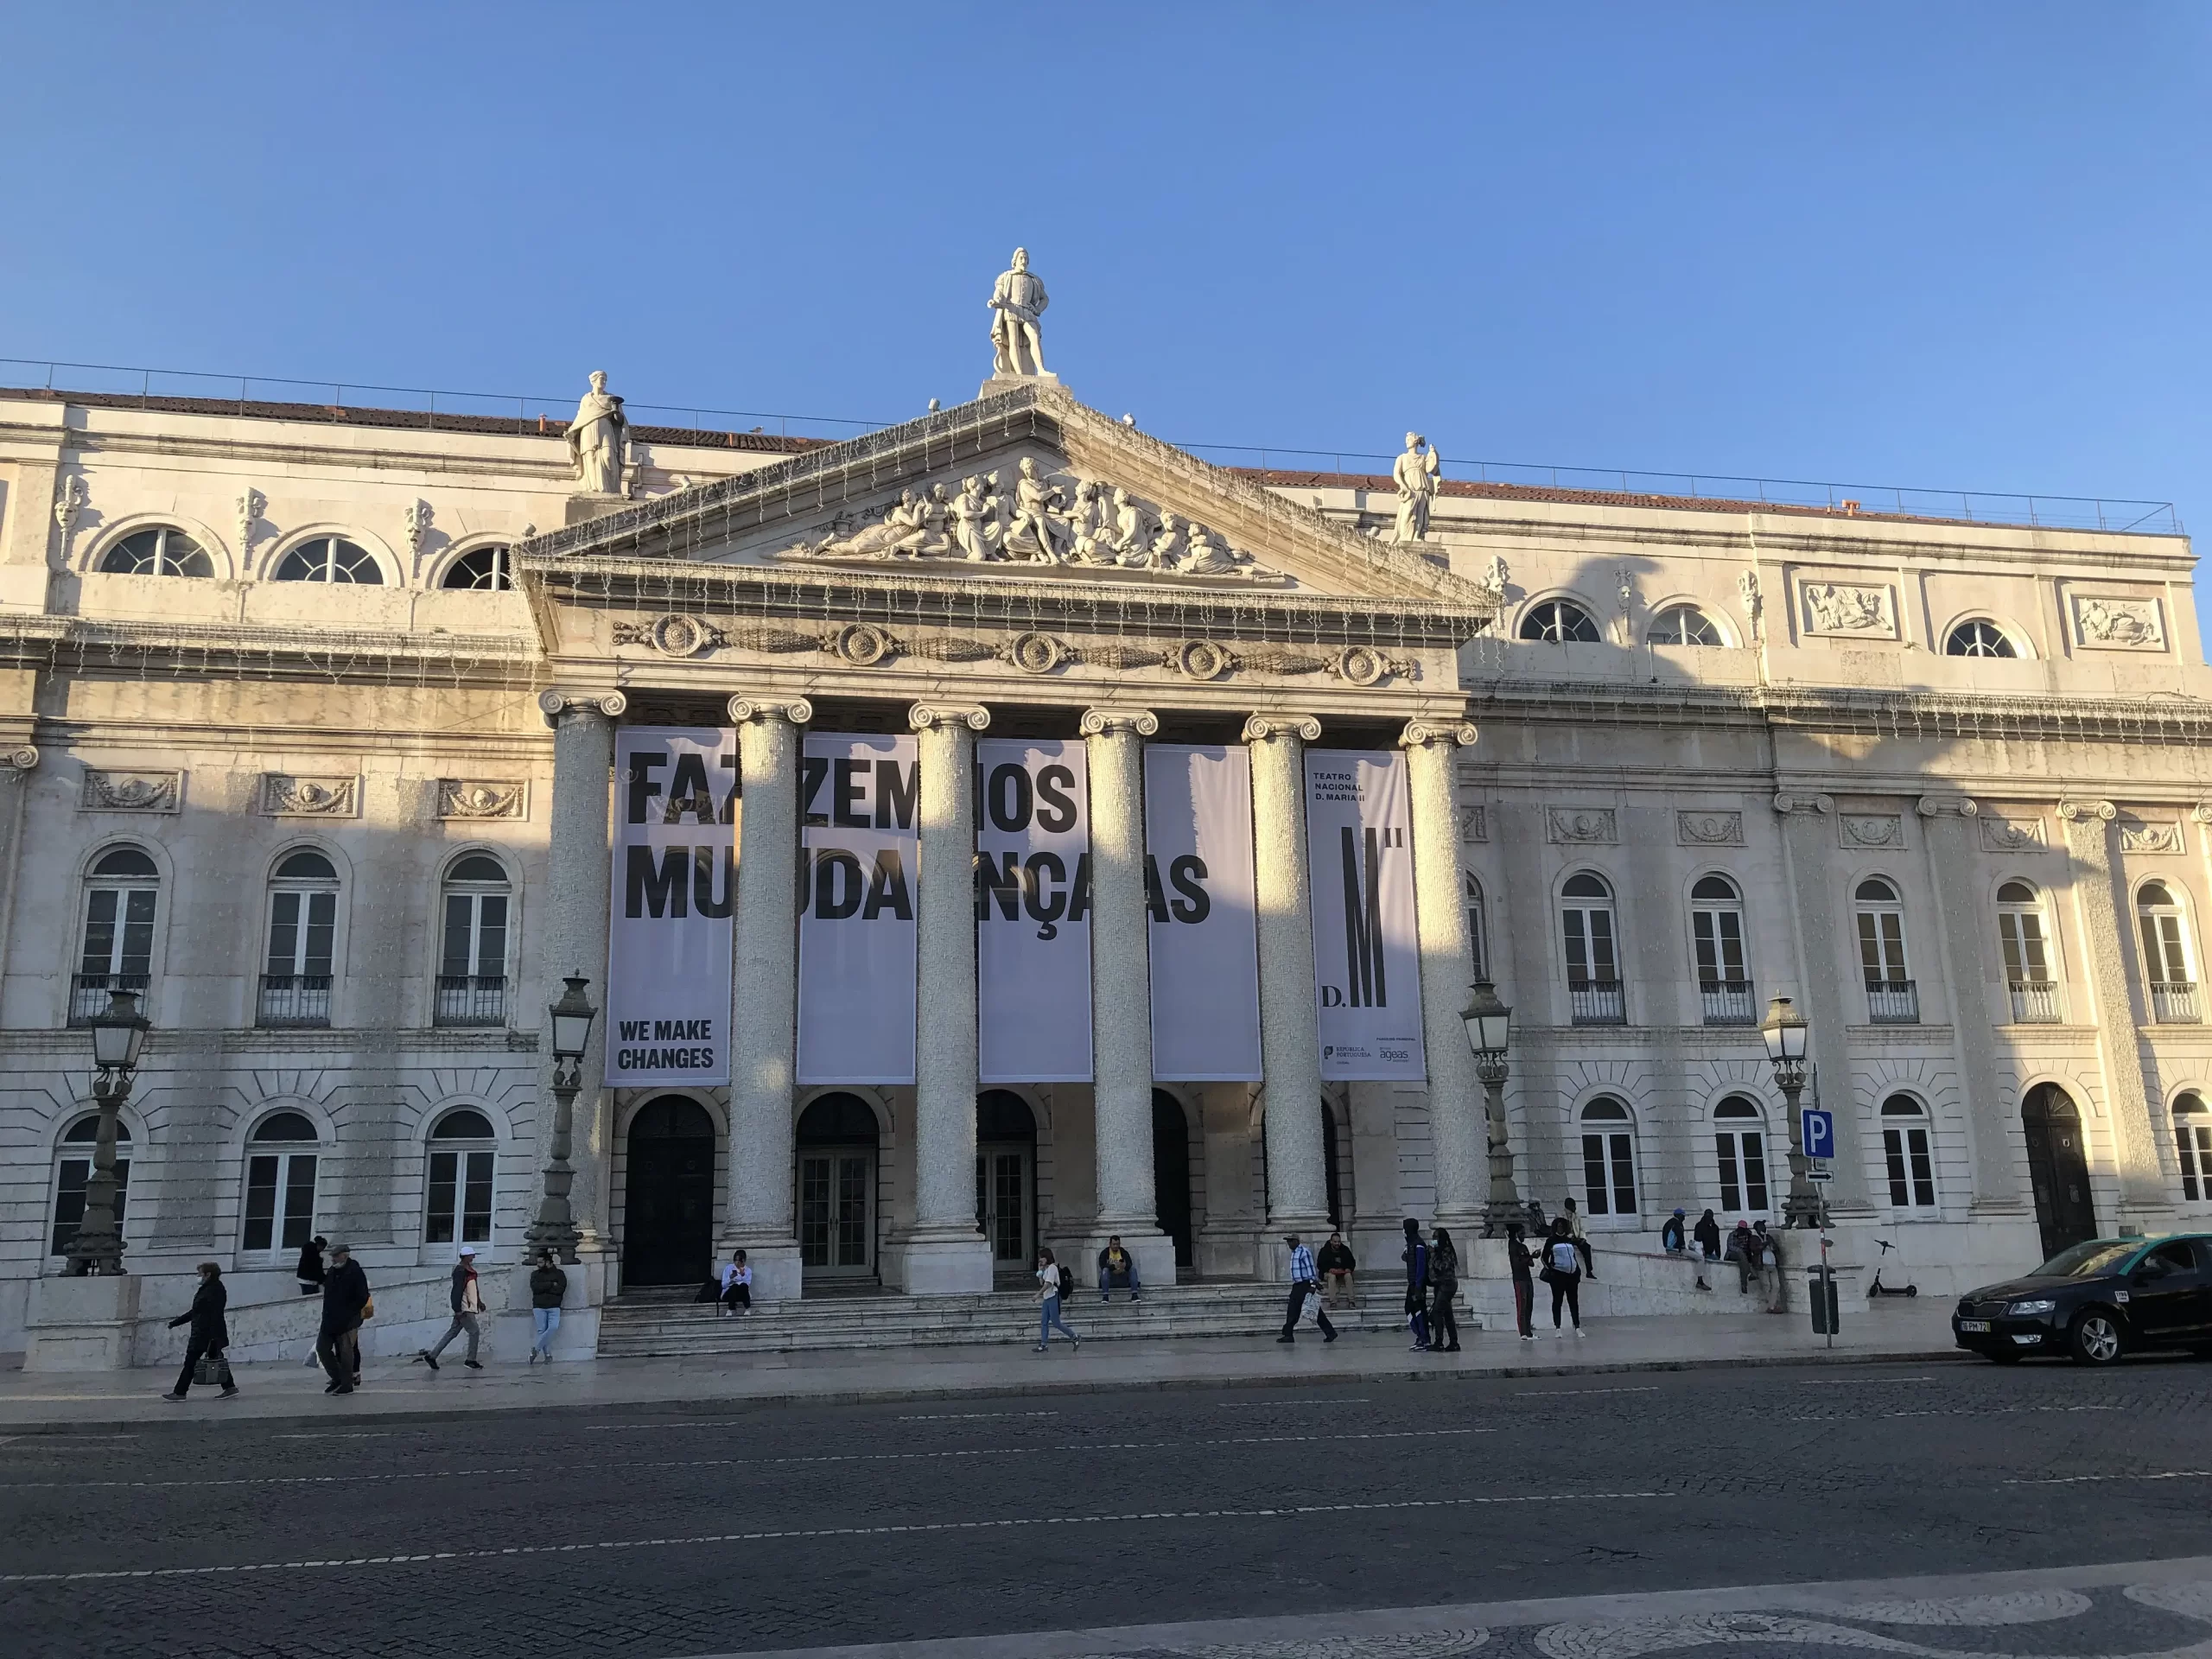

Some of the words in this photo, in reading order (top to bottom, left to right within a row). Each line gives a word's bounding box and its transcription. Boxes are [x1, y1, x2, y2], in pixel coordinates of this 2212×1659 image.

[1315, 783, 1363, 791] NACIONAL
[619, 1020, 650, 1041] WE
[654, 1020, 712, 1040] MAKE
[618, 1048, 714, 1070] CHANGES
[1380, 1050, 1408, 1062] ageas
[1808, 1114, 1827, 1154] P
